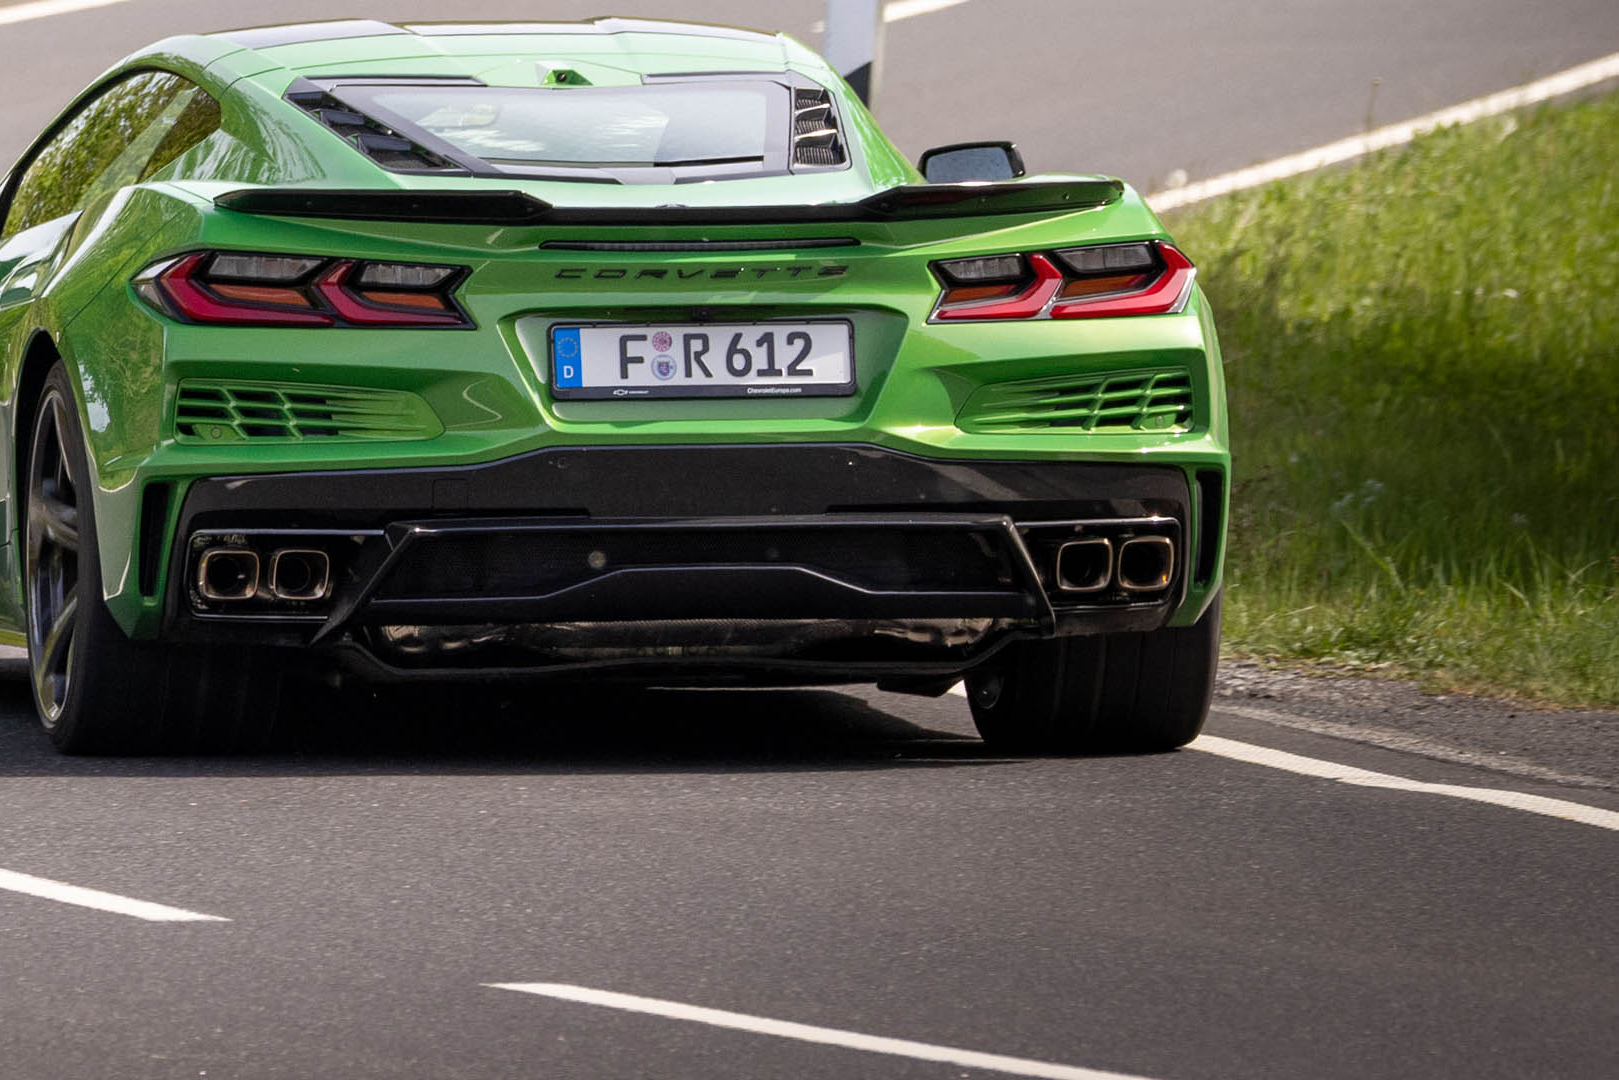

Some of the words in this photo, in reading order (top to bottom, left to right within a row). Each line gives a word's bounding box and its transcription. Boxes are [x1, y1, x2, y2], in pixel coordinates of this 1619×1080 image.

[554, 264, 851, 280] CORVETTE
[619, 334, 648, 380] F
[683, 333, 713, 378] R
[725, 331, 814, 378] 612
[563, 365, 574, 379] D
